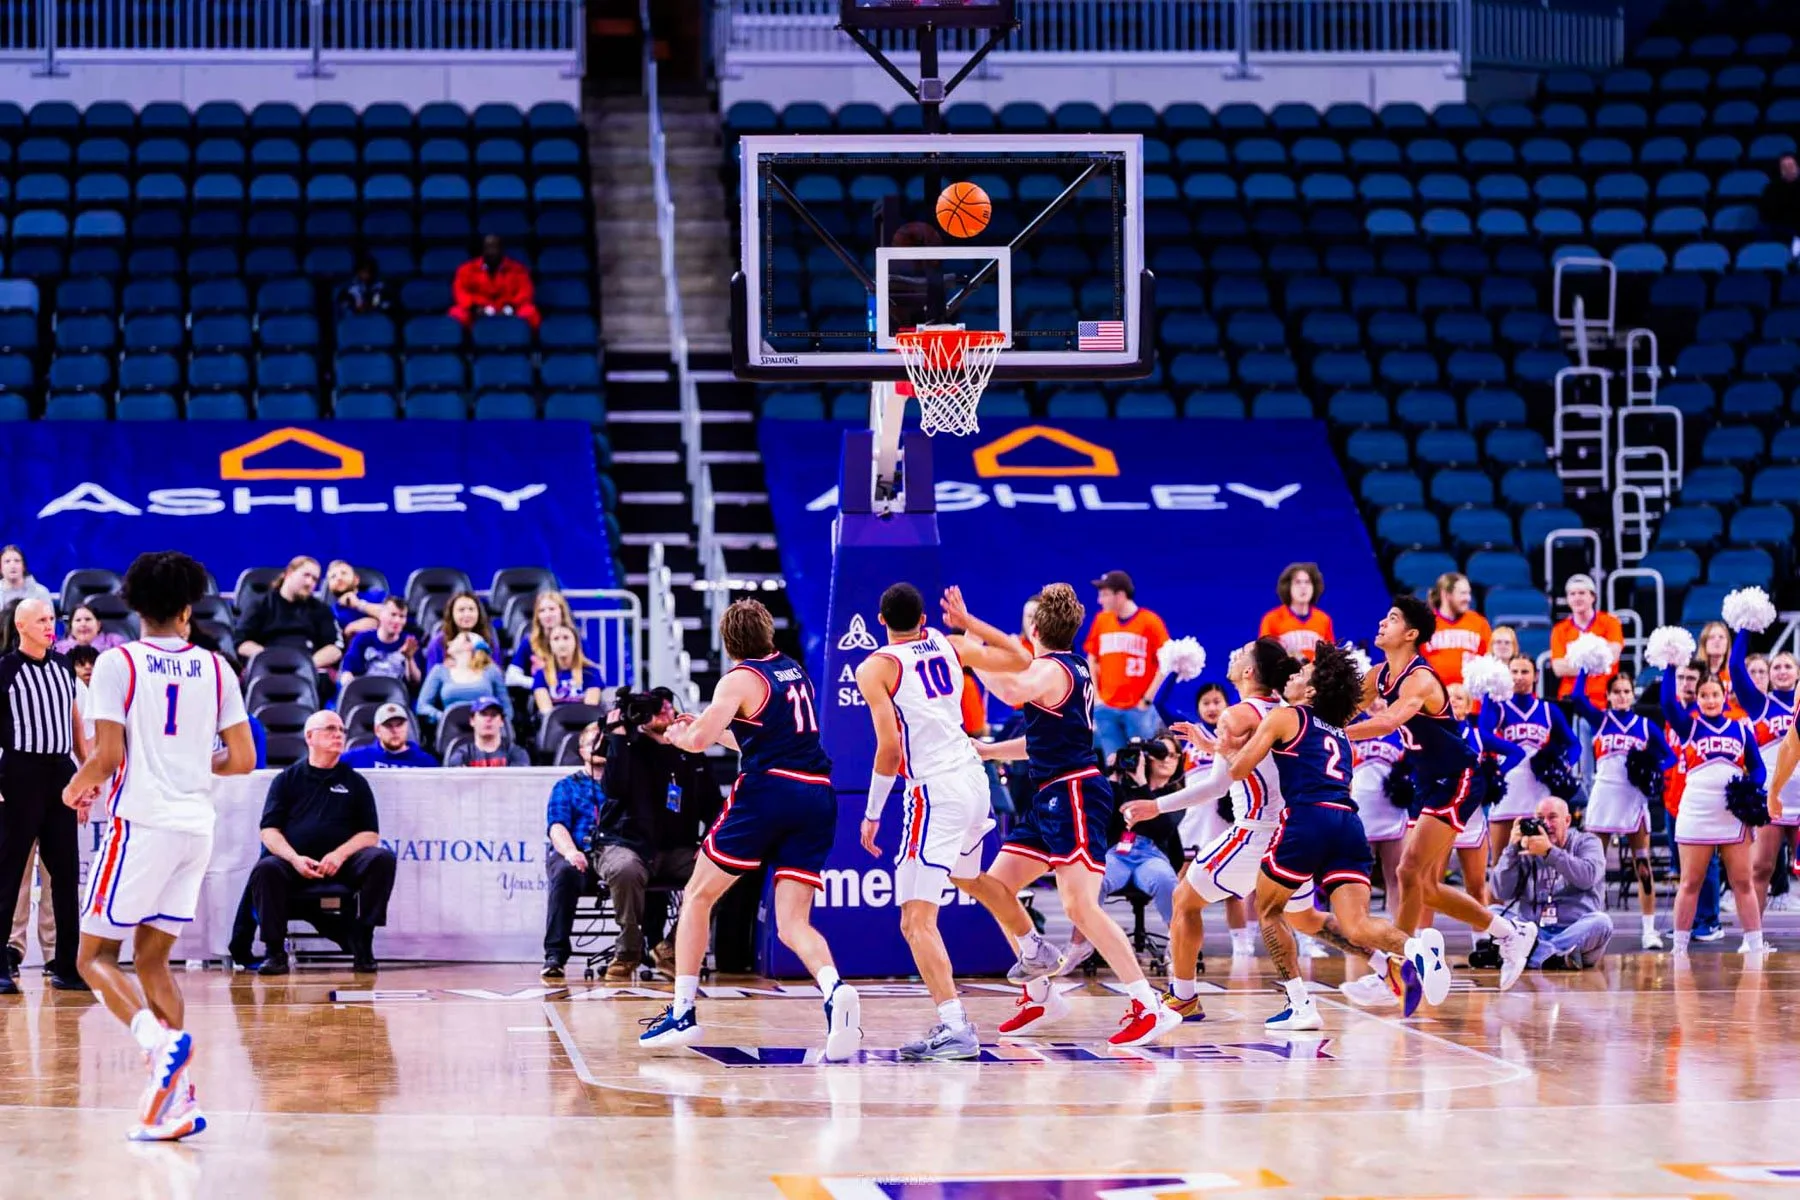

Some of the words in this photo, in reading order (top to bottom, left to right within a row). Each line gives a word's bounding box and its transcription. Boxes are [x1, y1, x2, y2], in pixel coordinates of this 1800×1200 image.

[760, 355, 798, 365] SPALDING
[37, 482, 548, 519] ASHLEY
[146, 654, 181, 677] SMITH
[187, 659, 202, 678] JR
[915, 655, 954, 699] 10
[786, 683, 818, 732] 11
[838, 687, 866, 706] St.
[164, 683, 179, 736] 1
[1504, 723, 1548, 744] ACES
[1601, 733, 1647, 751] ACES
[1324, 735, 1344, 780] 2
[1356, 740, 1401, 765] ACES
[1697, 735, 1742, 758] ACES
[381, 839, 534, 863] NATIONAL
[497, 871, 534, 900] Your
